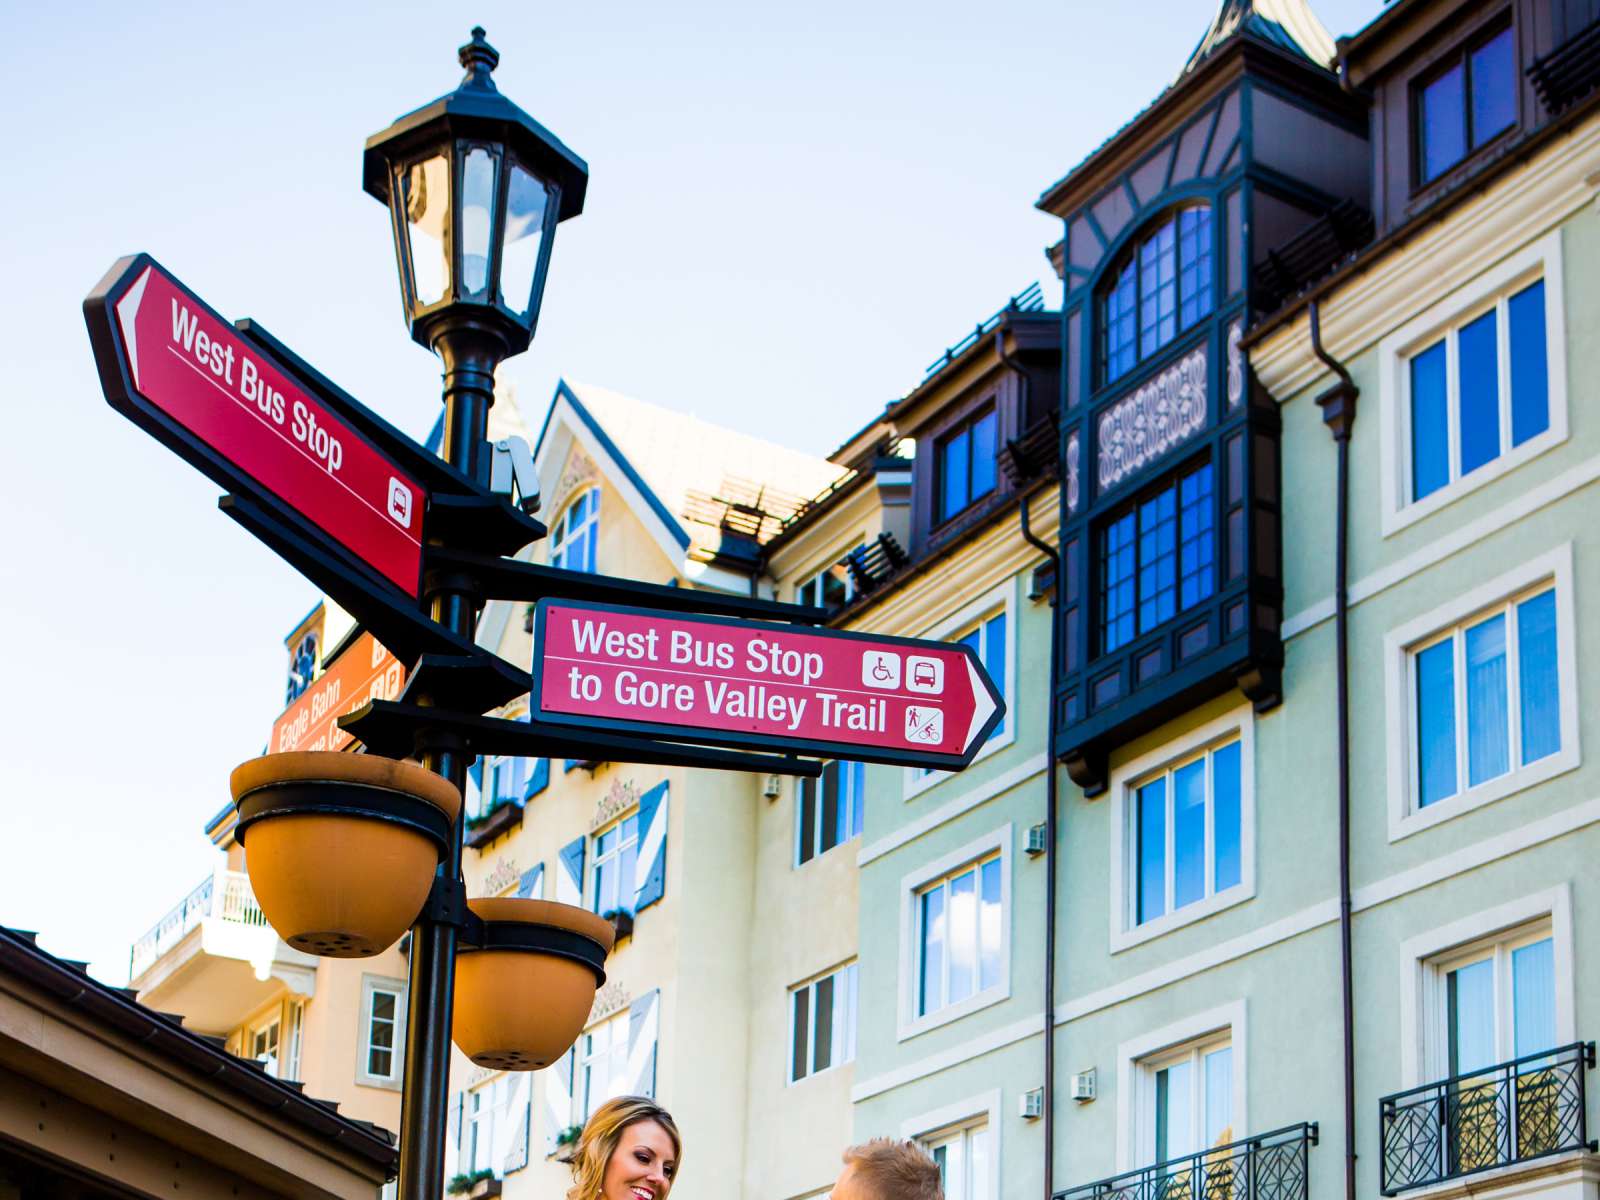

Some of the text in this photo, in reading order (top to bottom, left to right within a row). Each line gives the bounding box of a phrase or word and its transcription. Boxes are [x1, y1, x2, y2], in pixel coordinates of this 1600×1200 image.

[172, 297, 342, 474] West Bus Stop
[571, 618, 824, 685] West Bus Stop
[280, 678, 341, 751] Eagle Bahn
[568, 666, 886, 732] to Gore Valley Trail
